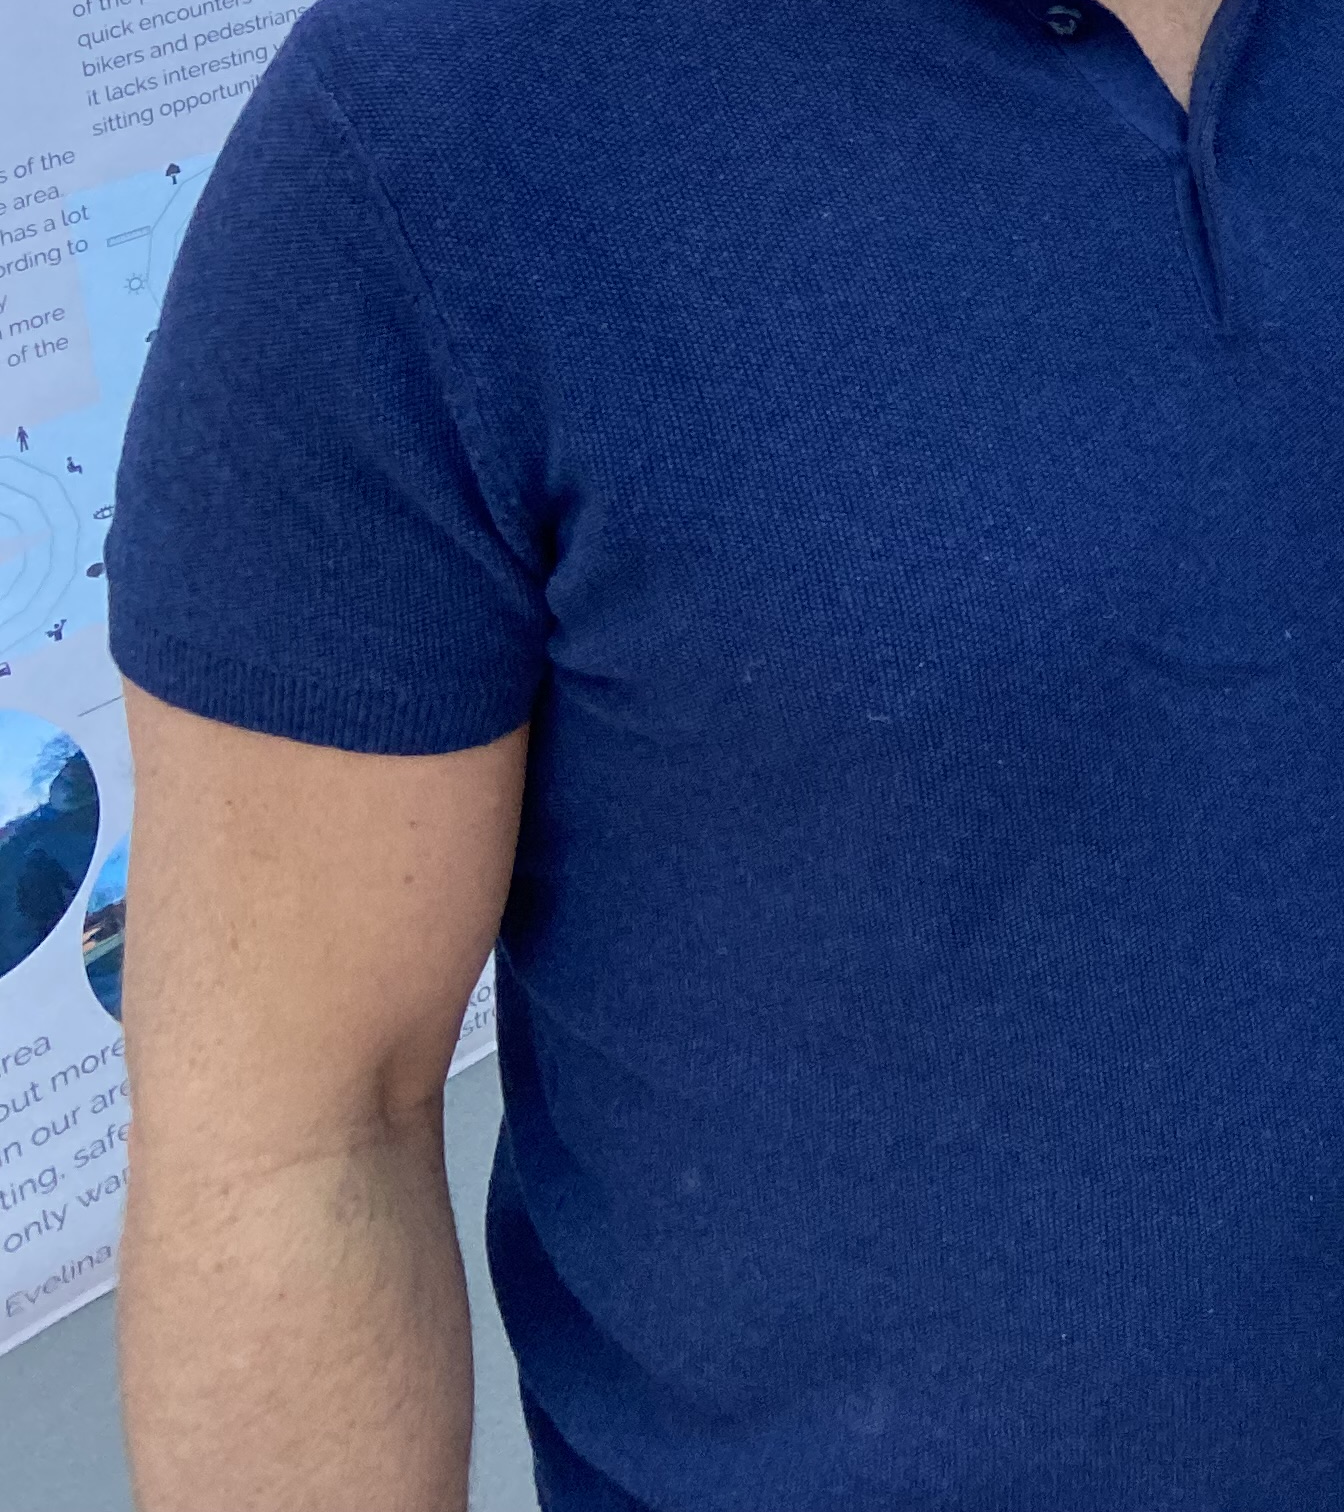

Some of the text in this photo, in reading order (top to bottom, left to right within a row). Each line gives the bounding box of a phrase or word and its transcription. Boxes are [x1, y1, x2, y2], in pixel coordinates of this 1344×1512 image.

[76, 19, 135, 51] quick
[81, 48, 146, 78] bikers
[149, 33, 189, 60] and
[86, 45, 269, 107] it lacks interesting
[91, 105, 154, 139] sitting
[13, 155, 36, 180] of
[40, 149, 76, 172] the
[0, 204, 91, 247] has a lot
[67, 237, 89, 257] to
[9, 306, 67, 337] more
[7, 335, 70, 368] of the
[0, 1035, 52, 1078] rea
[50, 1036, 126, 1093] more
[31, 1105, 82, 1147] our
[3, 1203, 69, 1254] only
[5, 1244, 113, 1318] Evelina
